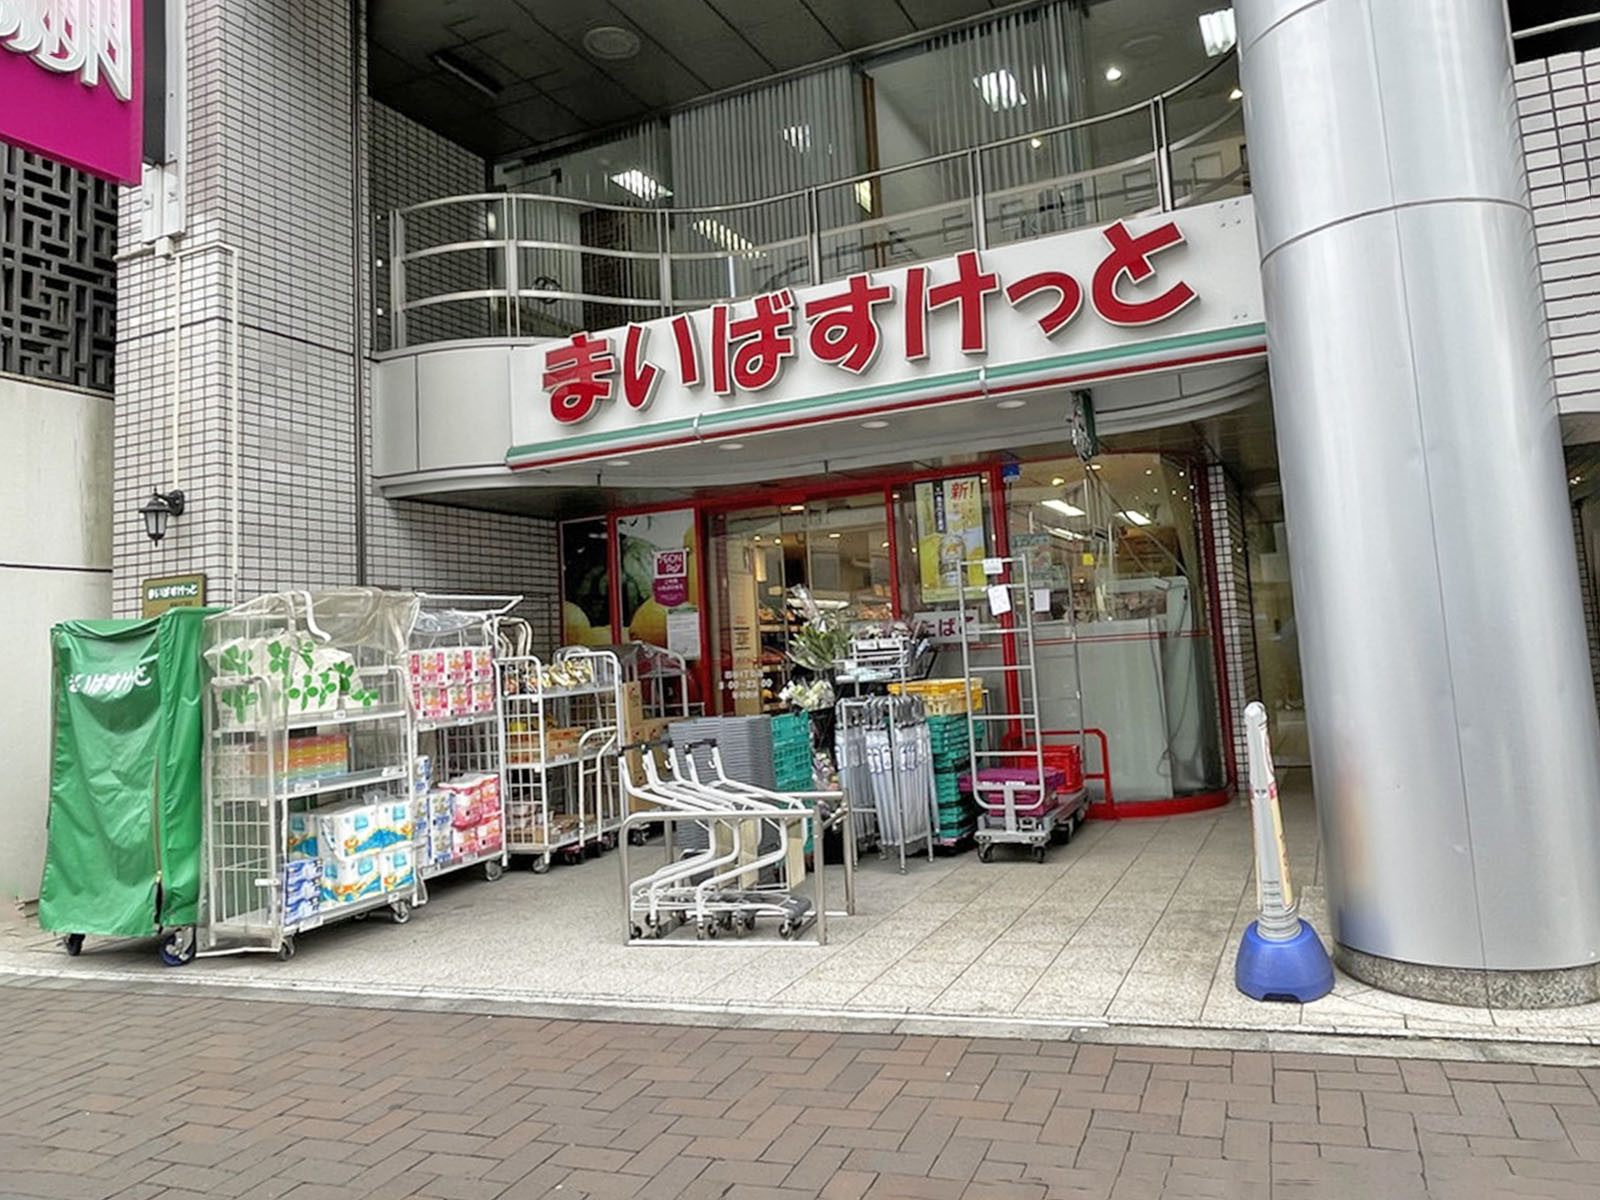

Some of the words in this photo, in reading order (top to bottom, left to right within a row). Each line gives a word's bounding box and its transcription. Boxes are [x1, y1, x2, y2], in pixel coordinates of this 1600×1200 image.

[542, 222, 1196, 424] まいばすけっと
